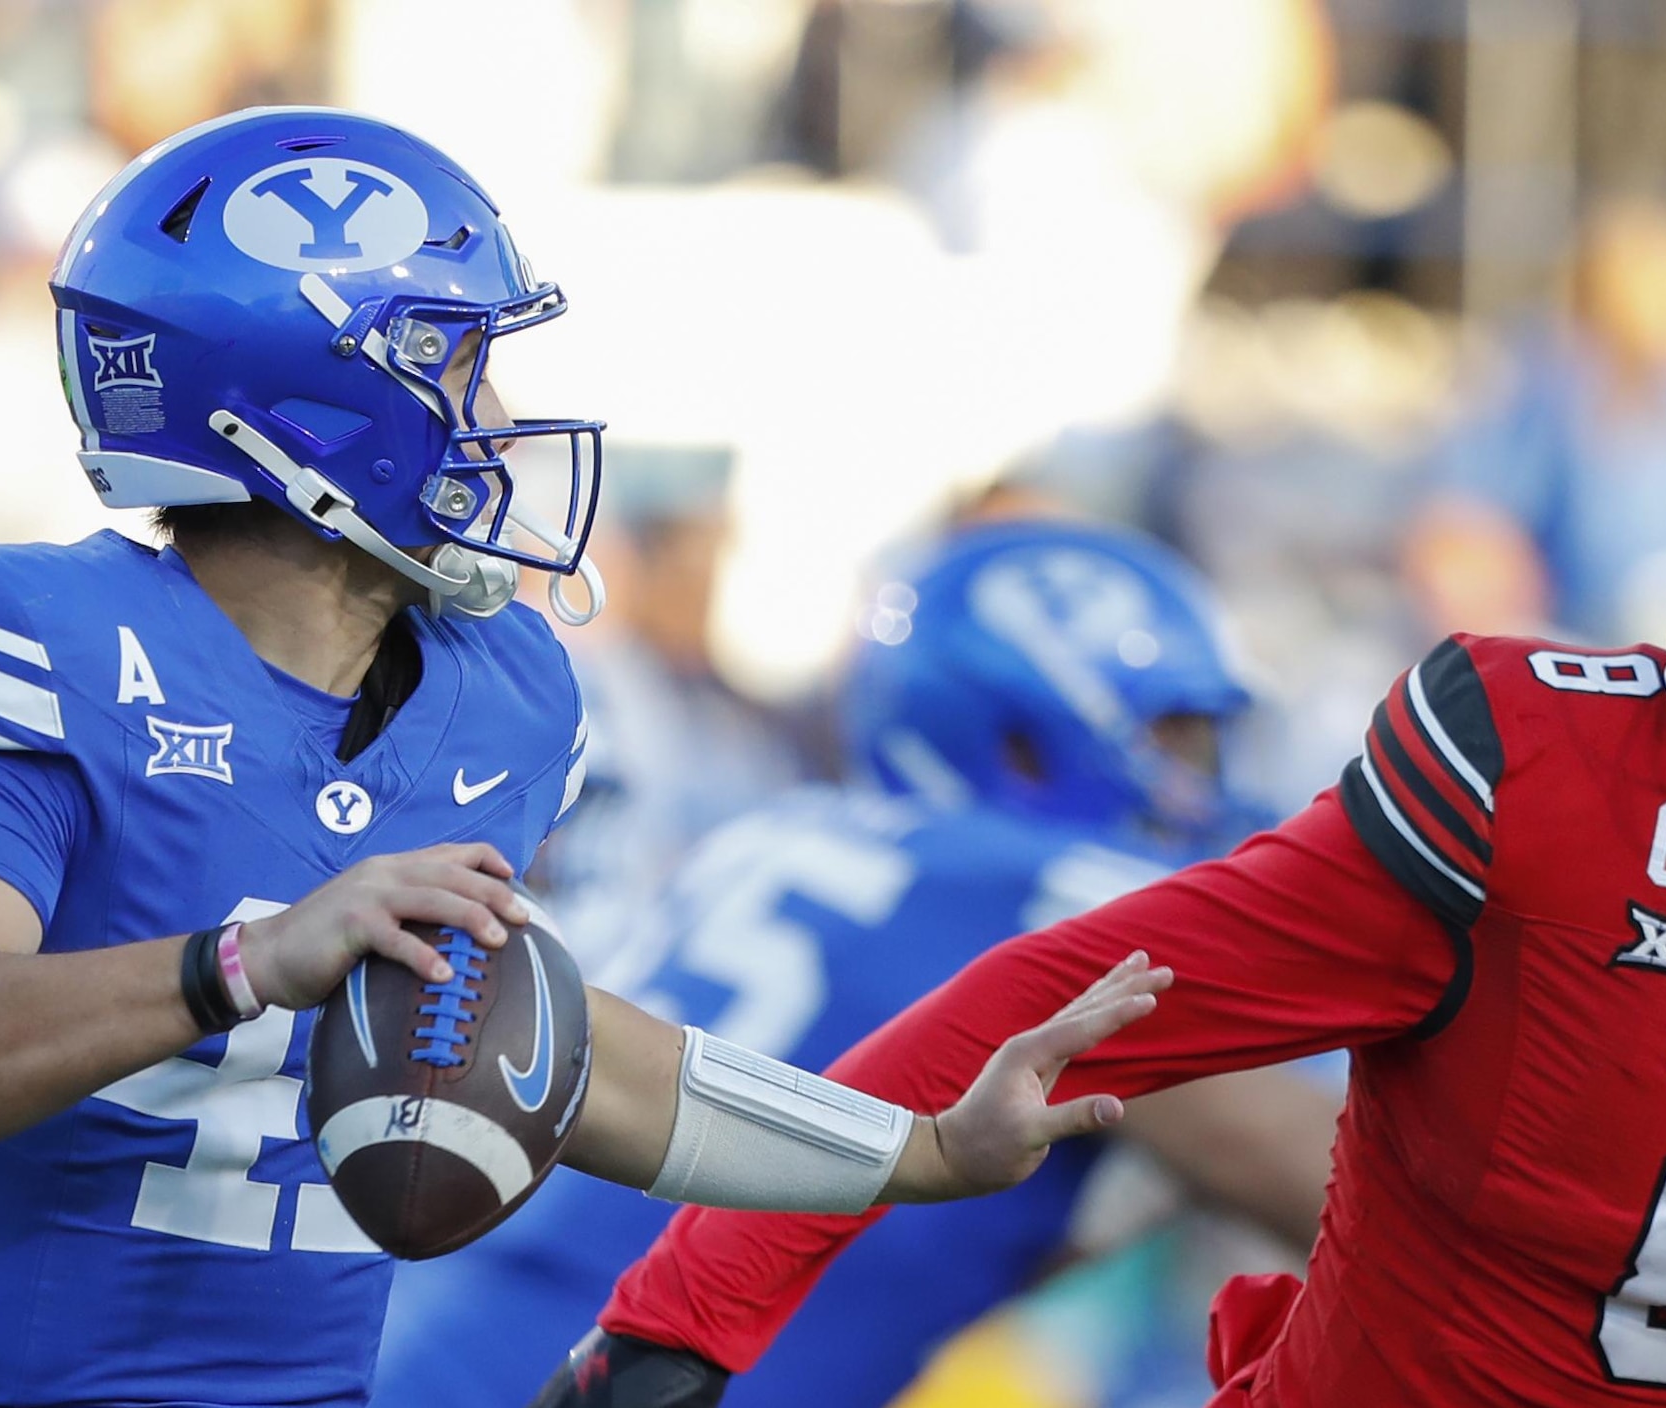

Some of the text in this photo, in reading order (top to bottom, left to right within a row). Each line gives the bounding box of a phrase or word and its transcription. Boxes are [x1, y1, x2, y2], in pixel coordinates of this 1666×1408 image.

[250, 167, 394, 260] Y
[90, 336, 160, 388] XII
[117, 625, 166, 705] A
[1527, 649, 1663, 698] 8
[148, 719, 231, 781] XII
[327, 790, 362, 826] Y
[90, 896, 383, 1253] 4
